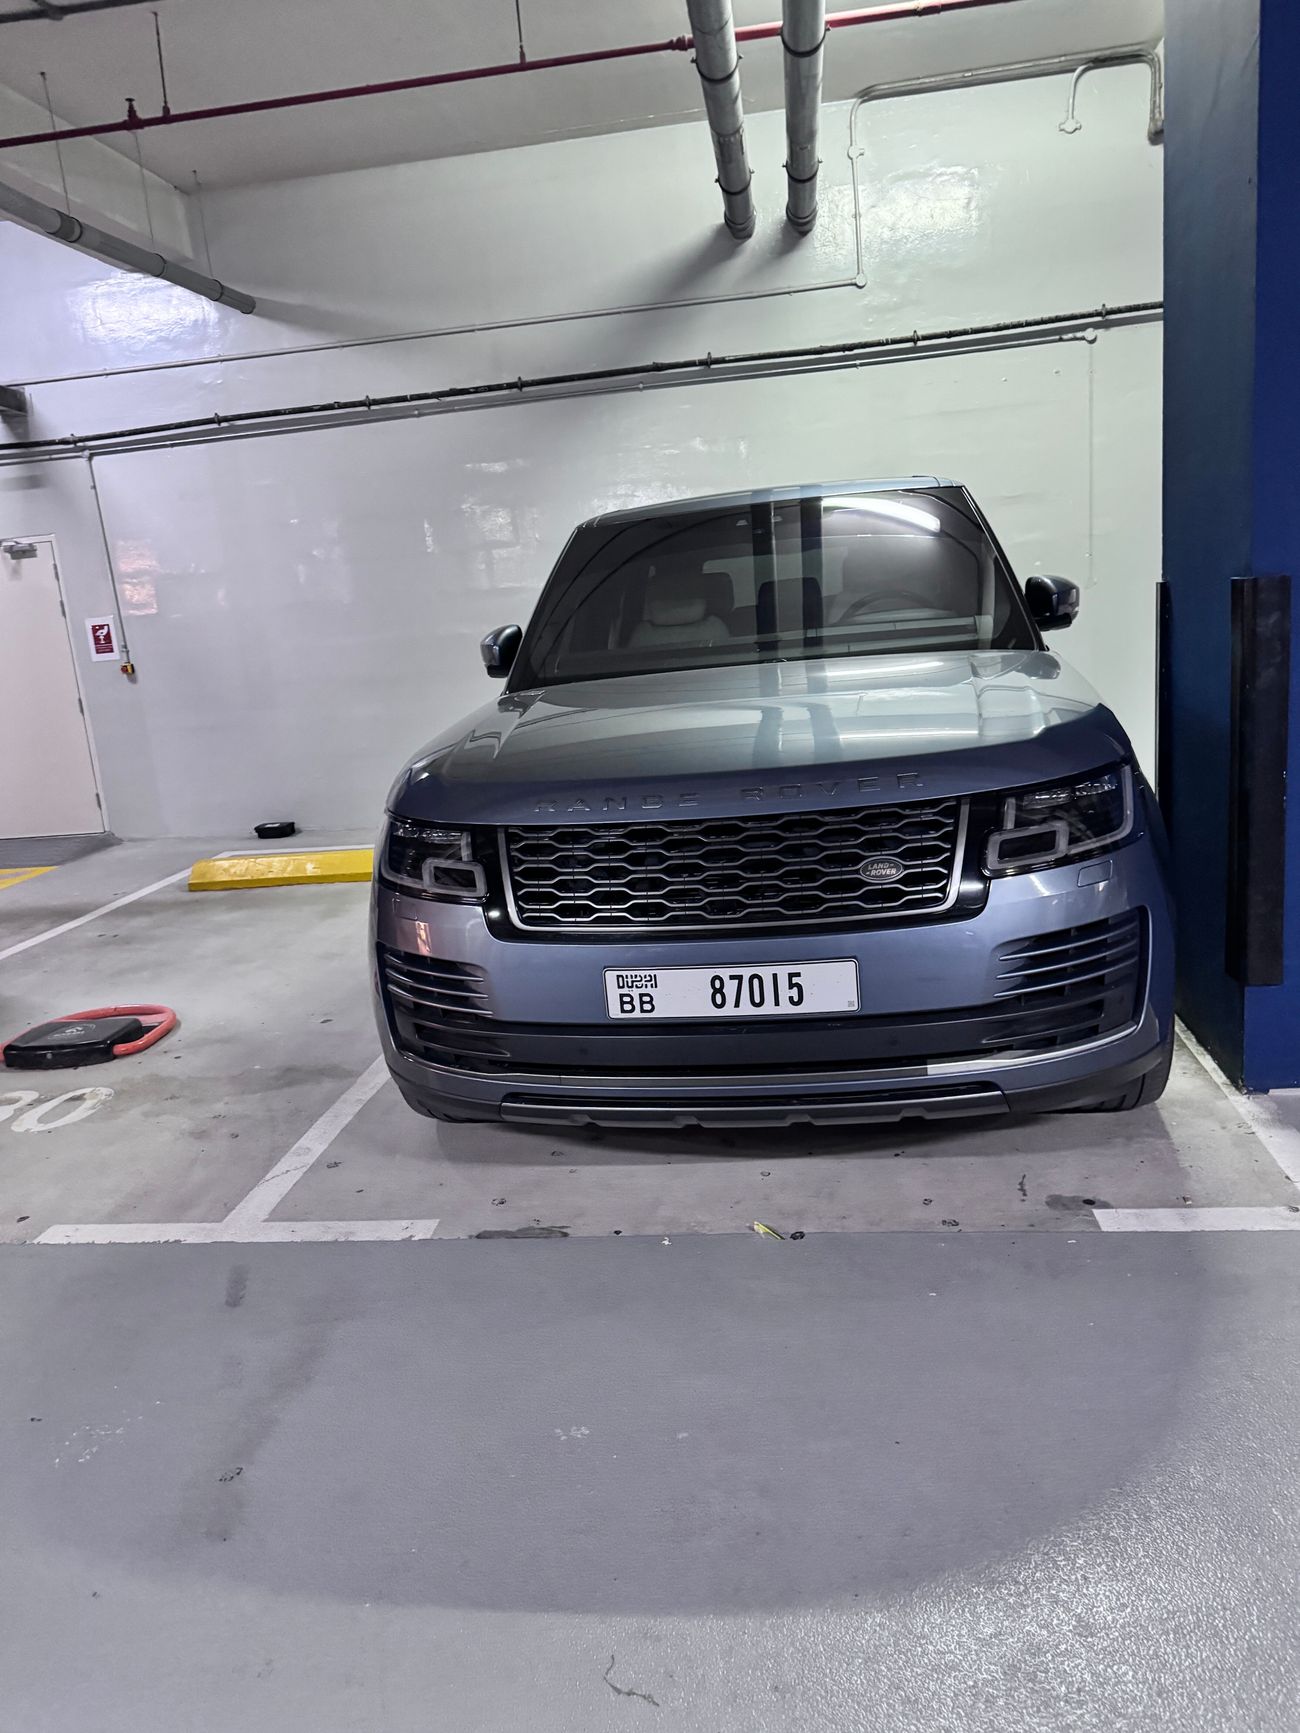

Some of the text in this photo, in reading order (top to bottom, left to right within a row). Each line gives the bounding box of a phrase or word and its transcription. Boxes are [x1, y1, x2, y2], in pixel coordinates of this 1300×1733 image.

[534, 772, 923, 812] RANGE ROVER
[868, 862, 890, 870] LAND
[870, 868, 897, 876] ROVER
[710, 972, 804, 1009] 87015
[619, 992, 656, 1014] BB
